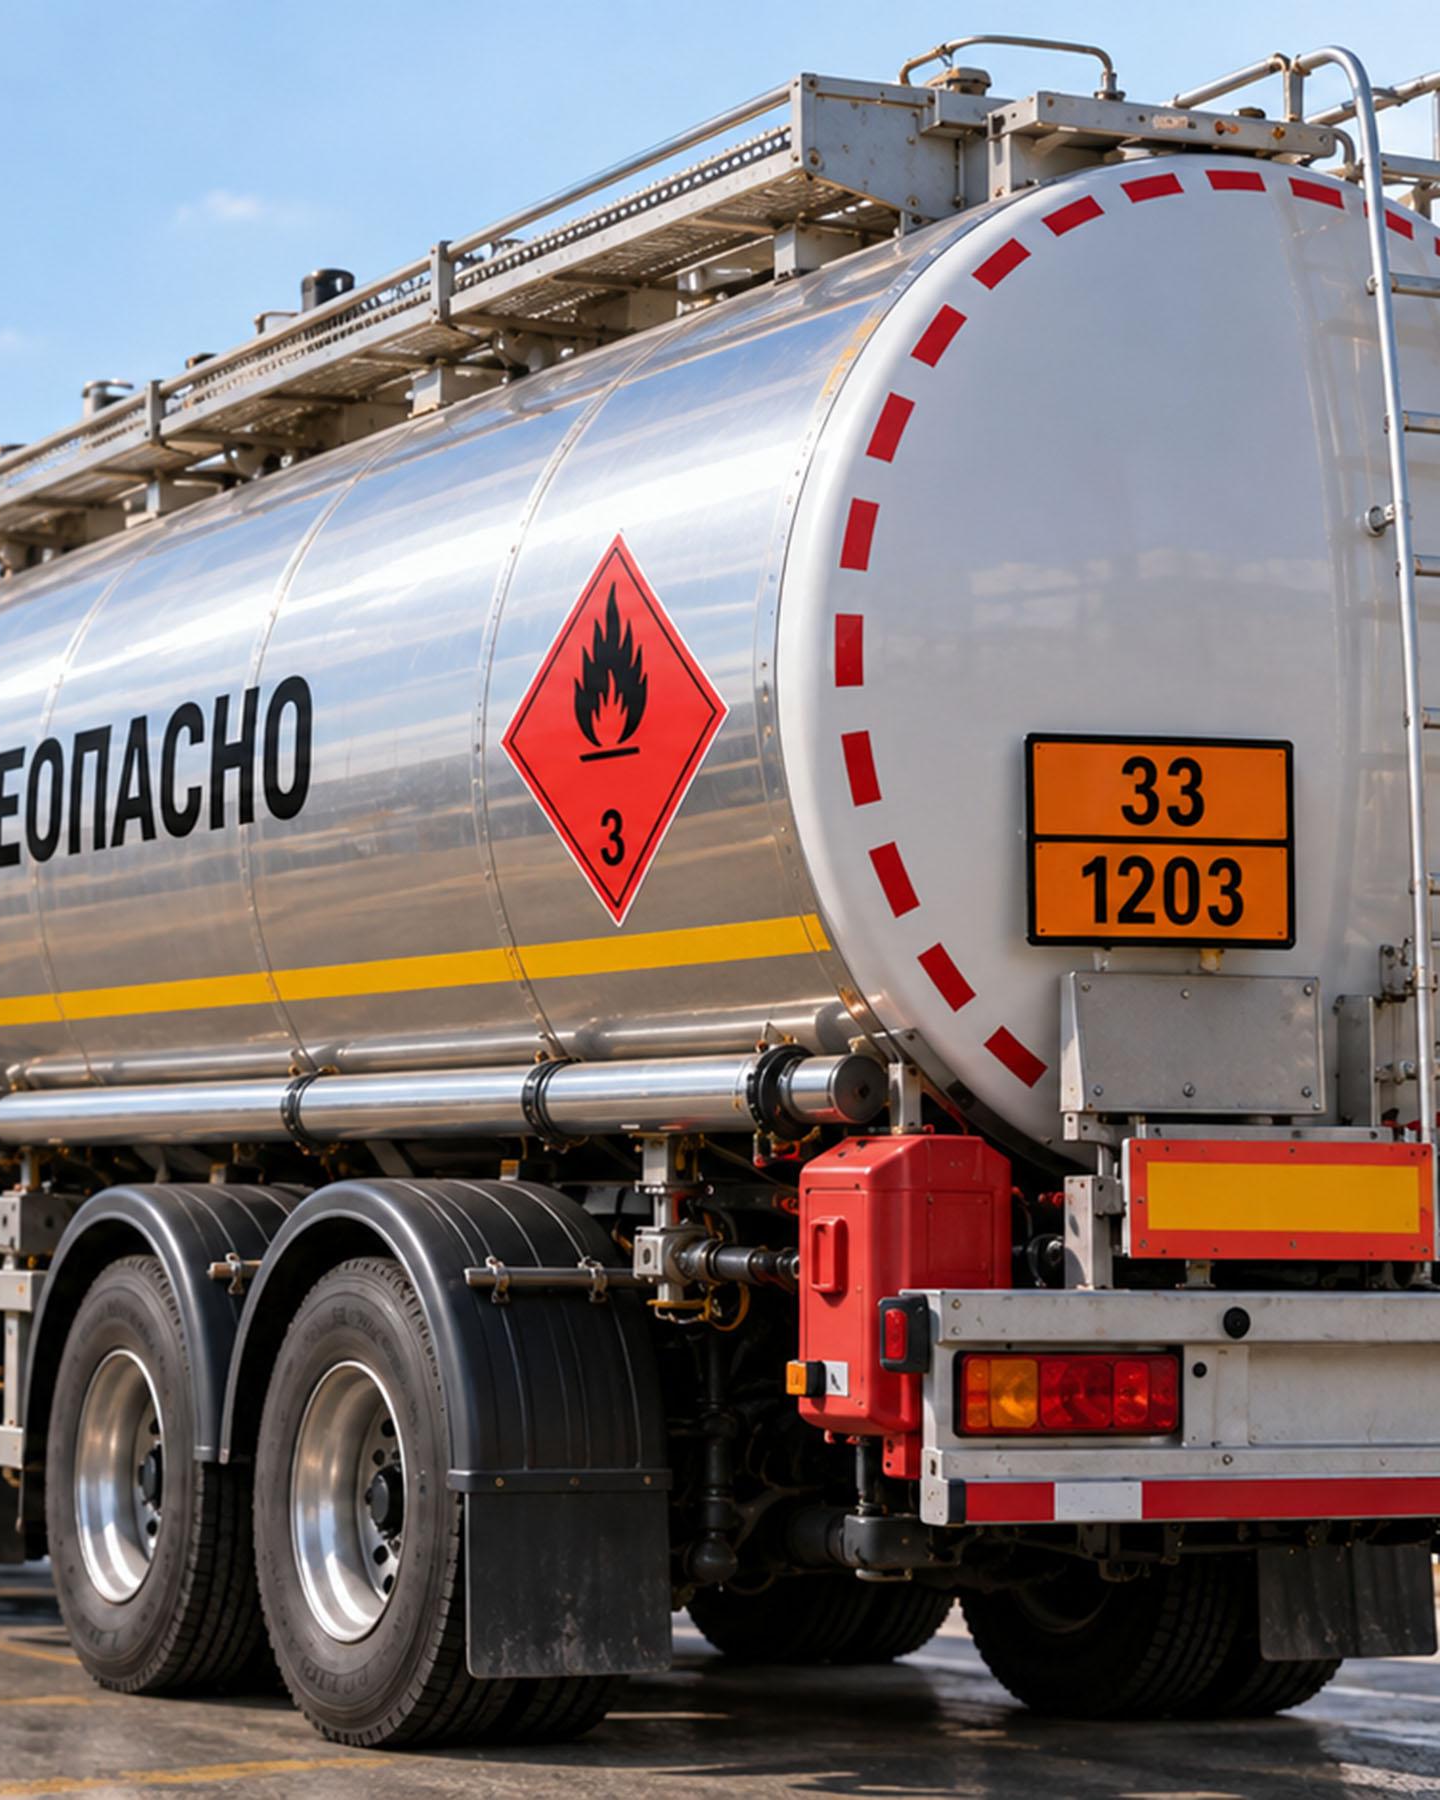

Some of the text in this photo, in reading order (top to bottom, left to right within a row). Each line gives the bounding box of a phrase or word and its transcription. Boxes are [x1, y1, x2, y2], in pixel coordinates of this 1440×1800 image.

[1121, 755, 1205, 828] 33
[599, 808, 626, 867] 3
[1081, 855, 1245, 927] 1203
